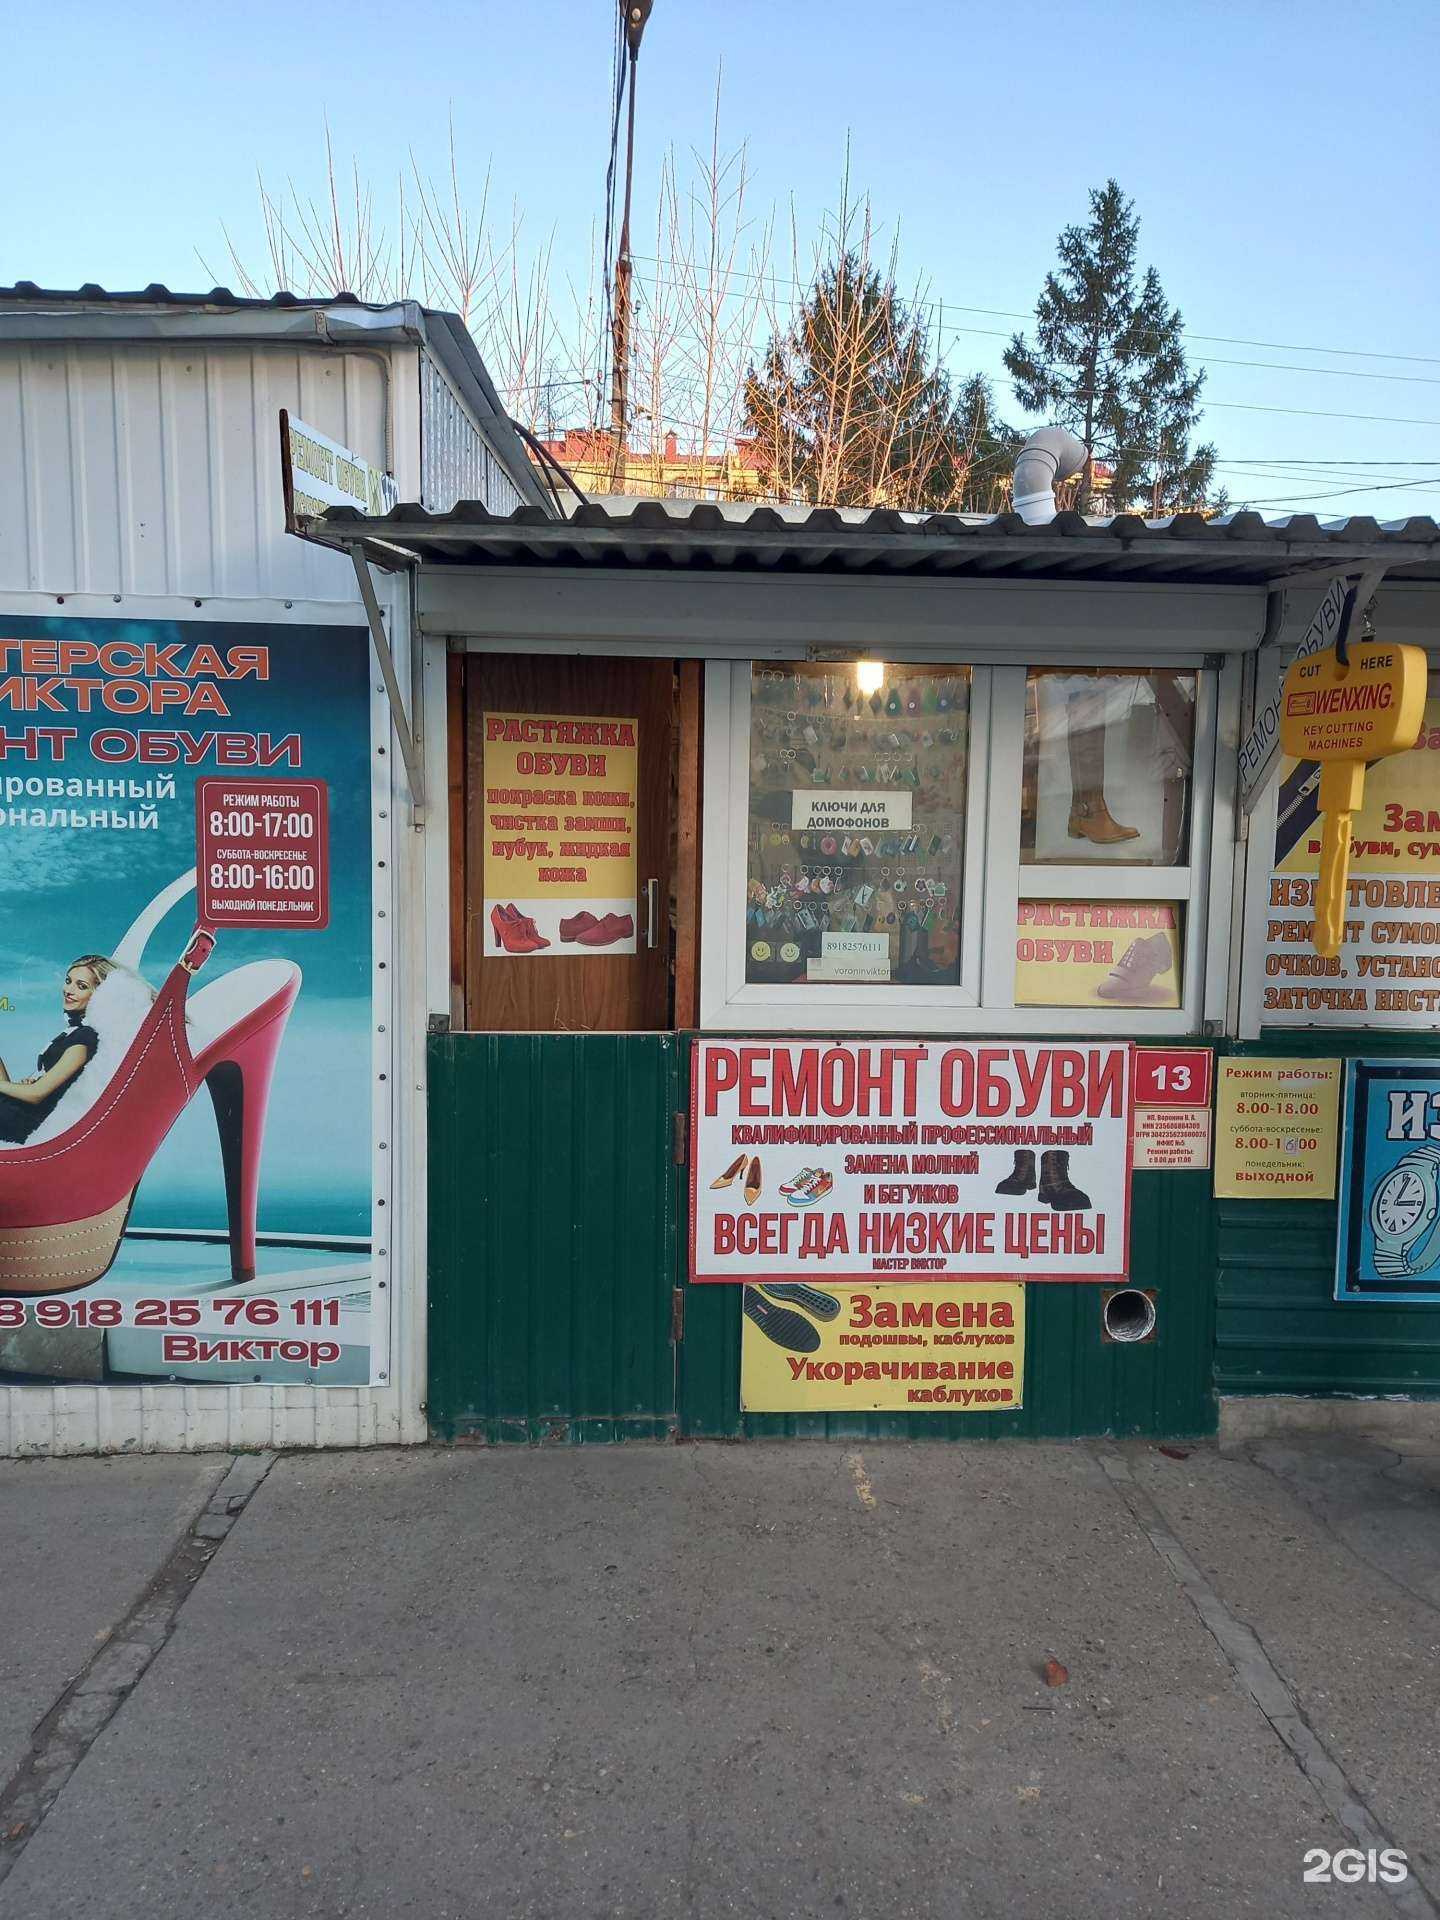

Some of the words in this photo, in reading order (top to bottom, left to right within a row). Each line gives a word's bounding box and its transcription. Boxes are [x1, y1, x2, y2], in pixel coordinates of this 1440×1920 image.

[1300, 664, 1321, 678] CUT
[1360, 655, 1393, 670] HERE
[1315, 682, 1393, 714] WENXING
[486, 718, 636, 746] РАСТЯЖКА
[1303, 725, 1322, 736] KEY
[1326, 721, 1374, 735] CUTTING
[90, 728, 302, 768] ОБУВИ
[1308, 737, 1364, 751] MACHINES
[516, 752, 607, 777] ОБУВИ
[0, 773, 176, 802] рованный
[487, 788, 577, 808] покраска
[582, 791, 635, 808] кожи,
[223, 794, 259, 807] РЕЖИМ
[261, 794, 300, 808] РАБОТЫ
[811, 801, 858, 814] КЛЮЧИ
[860, 802, 886, 815] ДЛЯ
[210, 811, 313, 838] 8:00-17:00
[490, 815, 558, 831] чистка
[564, 816, 631, 833] замши,
[807, 815, 889, 829] ДОМОФОНОВ
[216, 848, 308, 861] СУББОТА-ВОСКРЕСЕНЬЕ
[492, 838, 554, 860] нубук,
[560, 841, 631, 858] жидкая
[210, 864, 315, 890] 8:00-16:00
[538, 867, 587, 882] кожа
[211, 899, 256, 911] ВЫХОДНОЙ
[257, 901, 314, 912] ПОНЕДЕЛЬНИК
[1017, 902, 1177, 929] РАСТЯЖКА
[1371, 921, 1440, 943] СУМО
[1016, 938, 1114, 963] ОБУВИ
[1266, 953, 1348, 978] ОЧКОВ,
[1264, 987, 1368, 1010] ЗАТОЧКА
[1374, 988, 1440, 1011] ИНСТ
[704, 1048, 929, 1117] РЕМОНТ
[940, 1048, 1124, 1118] ОБУВИ
[1151, 1065, 1192, 1091] 13
[1226, 1068, 1272, 1079] Режим
[1278, 1068, 1333, 1081] работы:
[1240, 1091, 1316, 1099] вторник-пятница:
[1236, 1102, 1319, 1115] 8.00-18.00
[1386, 1090, 1440, 1141] И
[731, 1121, 918, 1146] КВАЛИФИЦИРОВАННЫЙ
[921, 1121, 1093, 1146] ПРОФЕССИОНАЛЬНЫЙ
[1230, 1125, 1324, 1134] суббота-воскресенье:
[844, 1153, 909, 1174] ЗАМЕНА
[912, 1150, 979, 1175] МОЛНИЙ
[1235, 1171, 1314, 1184] выходной
[864, 1184, 875, 1203] И
[878, 1184, 959, 1204] БЕГУНКОВ
[714, 1212, 849, 1259] ВСЕГДА
[858, 1212, 995, 1254] НИЗКИЕ
[1004, 1212, 1106, 1258] ЦЕНЫ
[872, 1257, 909, 1270] МАСТЕР
[911, 1257, 947, 1270] ВИКТОР
[34, 1298, 123, 1328] 918
[133, 1299, 201, 1328] 25
[212, 1299, 280, 1328] 76
[290, 1298, 341, 1328] 111
[849, 1294, 1015, 1329] Замена
[162, 1334, 341, 1368] Виктор
[840, 1332, 928, 1347] подошвы,
[933, 1332, 1015, 1348] каблуков
[786, 1356, 1014, 1385] Укорачивание
[907, 1385, 1014, 1407] каблуков
